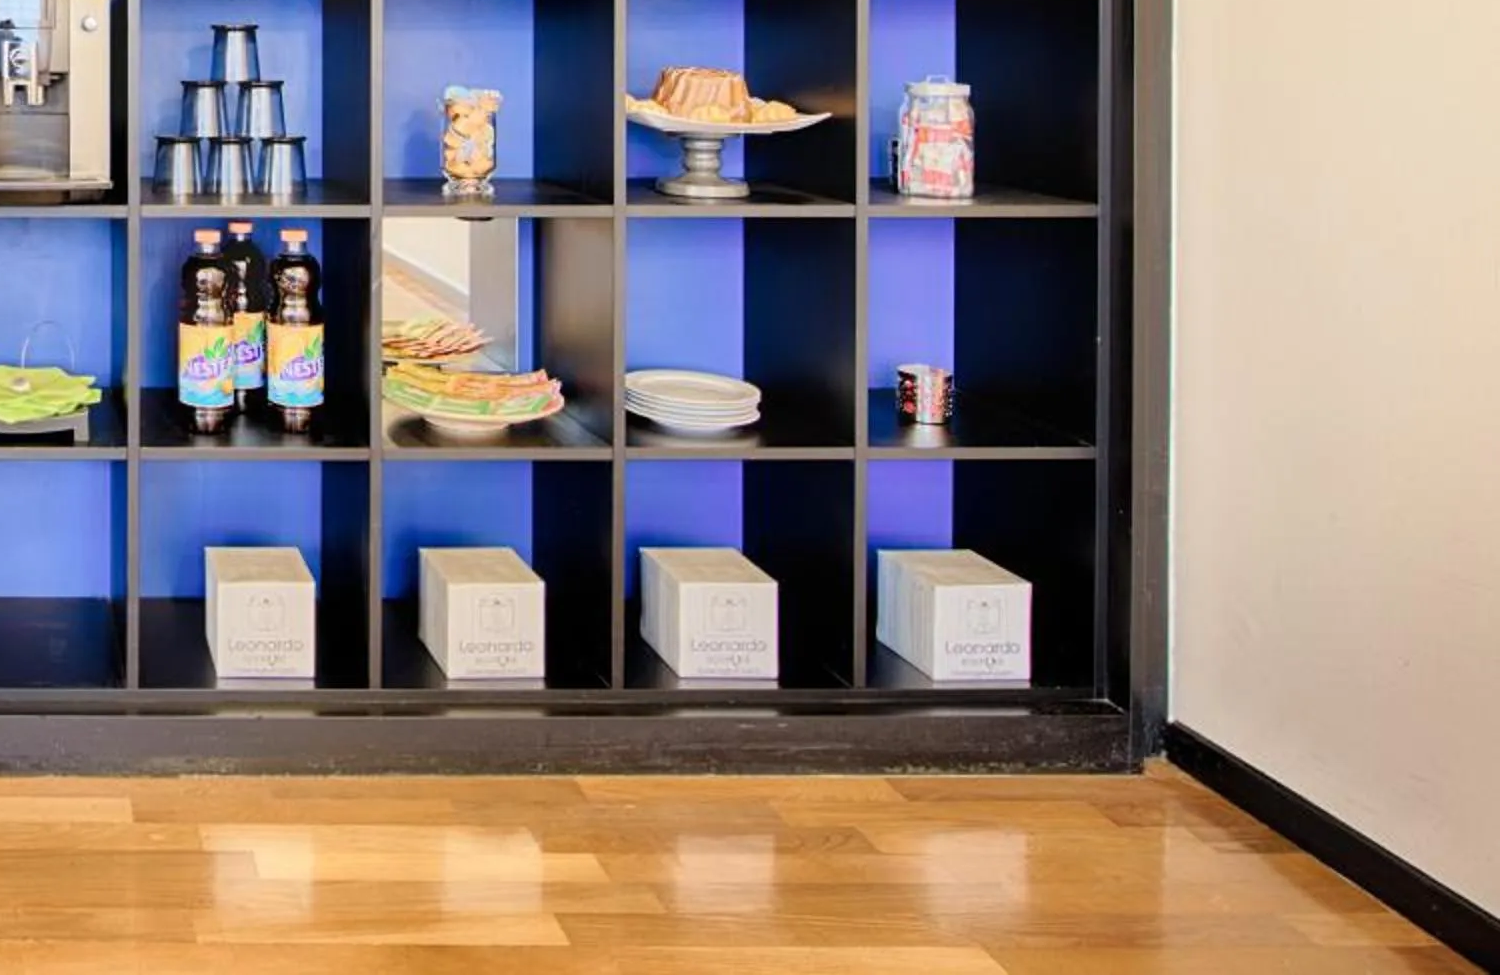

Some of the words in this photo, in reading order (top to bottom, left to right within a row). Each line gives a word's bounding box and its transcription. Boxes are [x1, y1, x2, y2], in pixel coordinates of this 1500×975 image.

[228, 638, 304, 652] Leonardo
[459, 639, 535, 653] Leonardo
[691, 638, 768, 652] Leonardo
[945, 640, 1020, 654] Leonardo
